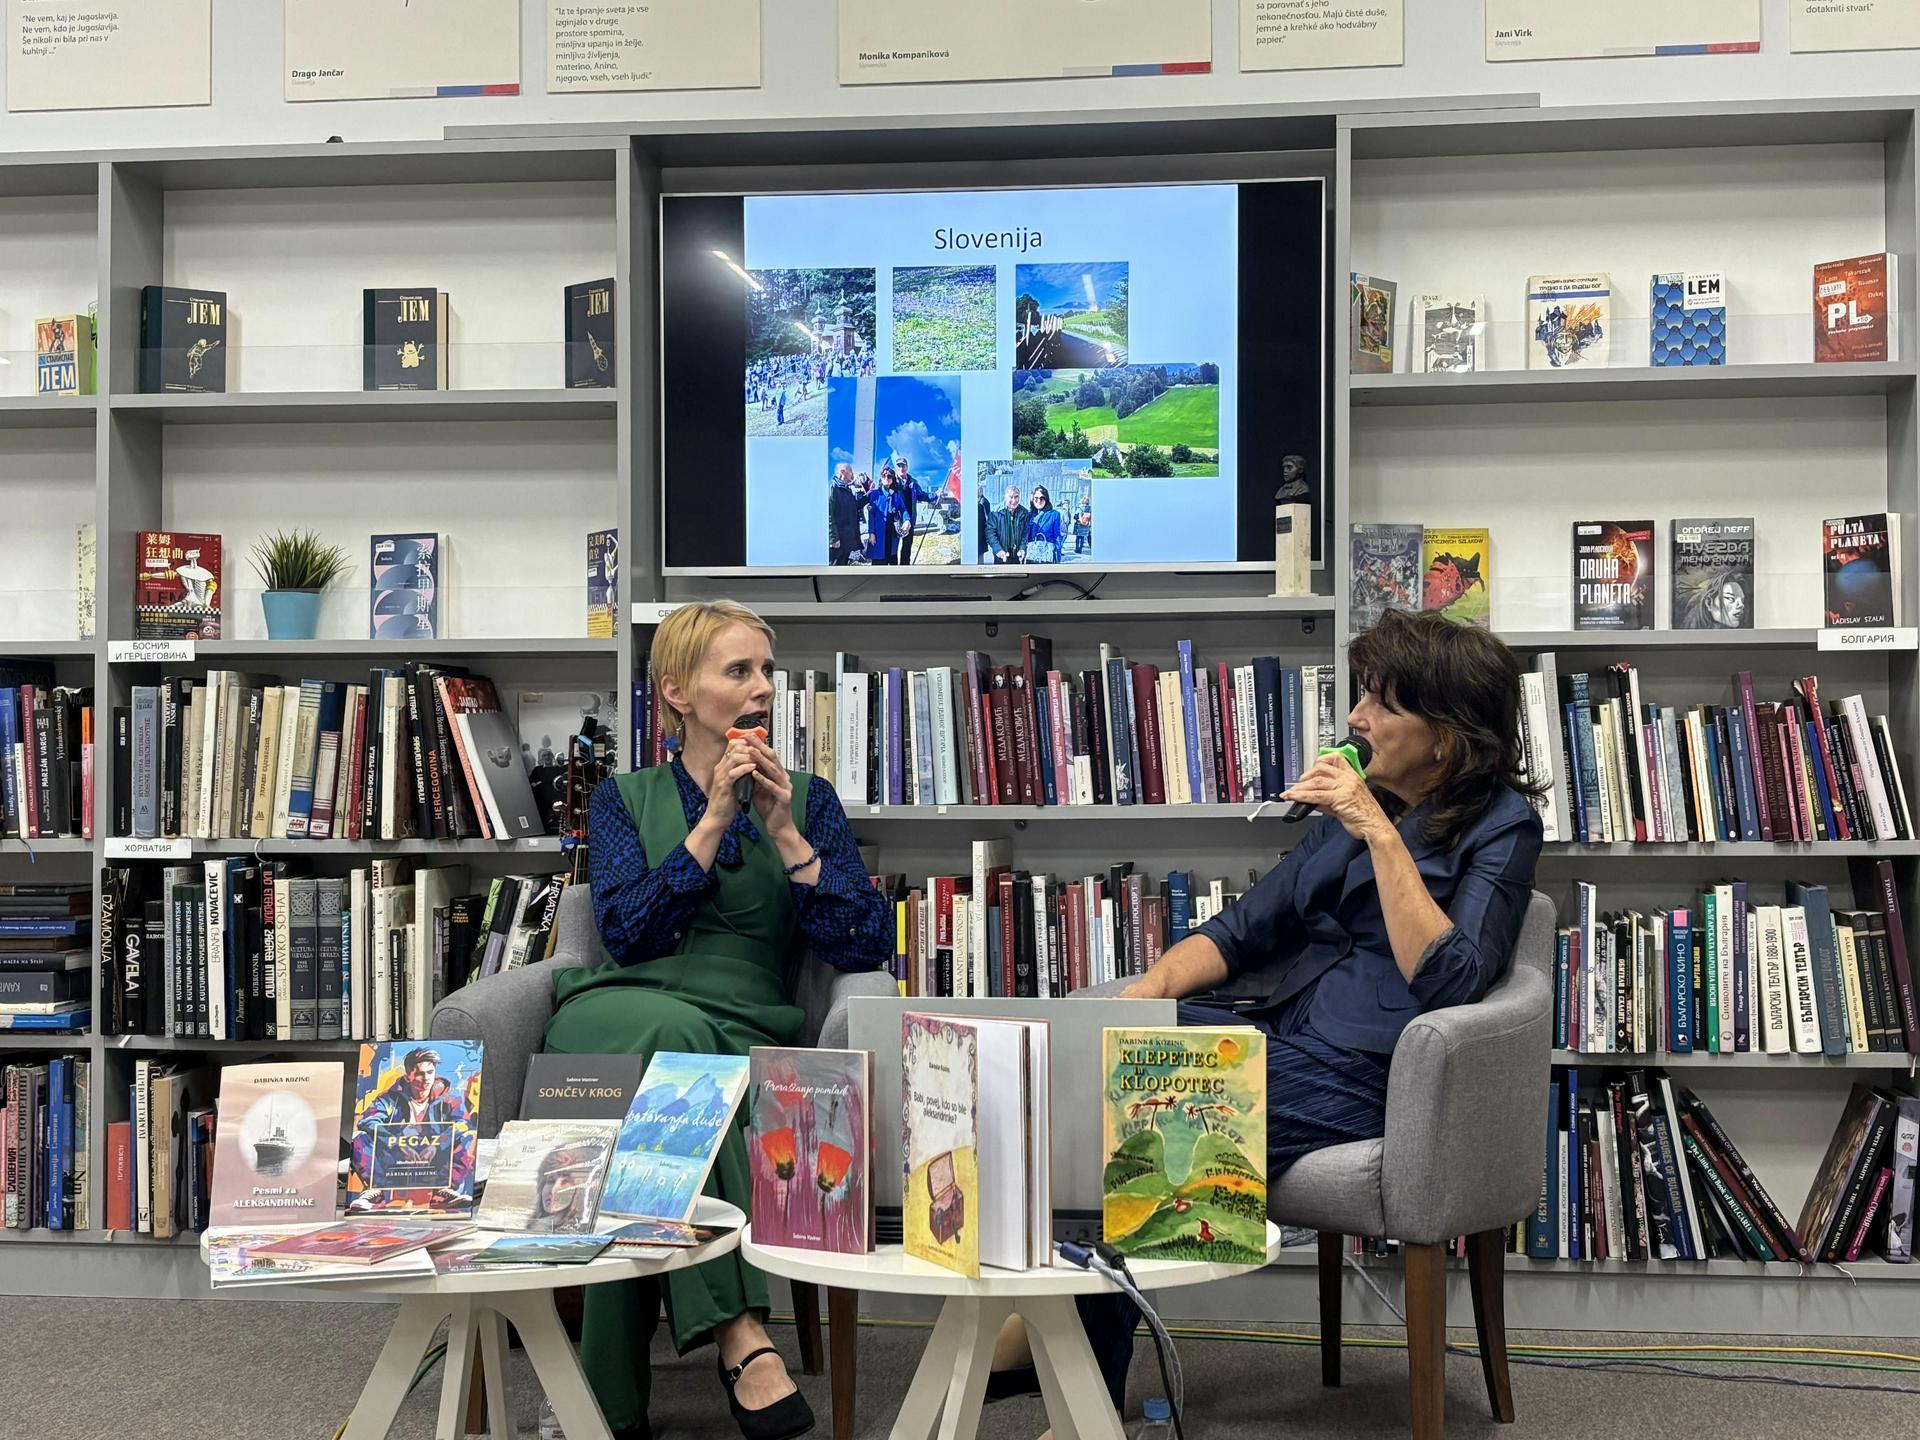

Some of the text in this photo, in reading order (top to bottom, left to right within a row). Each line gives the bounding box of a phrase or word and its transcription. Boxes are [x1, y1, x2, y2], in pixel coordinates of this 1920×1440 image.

[37, 12, 120, 24] vem, kaj je Jugoslavija.
[567, 8, 575, 16] te
[606, 7, 627, 15] sveta
[627, 7, 635, 15] je
[636, 6, 650, 14] vse
[1323, 9, 1344, 20] Majú
[1805, 4, 1844, 14] dotakniti
[22, 23, 120, 35] Ne vem, kdo je Jugoslavija.
[595, 18, 619, 28] druge
[1319, 22, 1335, 31] ako
[33, 35, 52, 45] nikoli
[54, 36, 62, 44] ni
[63, 34, 77, 44] bila
[78, 34, 89, 45] pri
[90, 35, 103, 43] nas
[555, 30, 588, 40] prostore
[615, 39, 623, 47] in
[1495, 28, 1534, 40] Jani Virk
[22, 46, 48, 57] kuhinji
[858, 50, 891, 62] Monika
[291, 68, 345, 80] Drago Jančar
[934, 227, 1042, 253] Slovenija
[1687, 278, 1721, 297] LEM
[39, 364, 77, 393] ЛЕМ
[1724, 525, 1751, 533] NEFF
[146, 547, 184, 560] 狂想曲
[1579, 580, 1631, 605] PLANÉTA
[1832, 616, 1861, 625] LADISLAV
[132, 641, 170, 651] БОСНИЯ
[1841, 634, 1895, 645] БОЛГАРИЯ
[115, 651, 188, 662] И ГЕРЦЕГОВИНА
[994, 706, 1008, 761] МЕДАКОВИЋ
[1013, 707, 1027, 762] МЕДАКОВИЋ
[40, 731, 49, 787] MARIÁN VARGA
[427, 749, 443, 820] HERCEGOVINA
[124, 843, 172, 854] ХОРВАТИЯ
[975, 854, 983, 922] MONOGRAFIJA
[540, 878, 562, 932] HRVATSKA
[262, 870, 275, 961] IVO ZAGREB
[101, 894, 114, 963] DŽAMONJA
[275, 892, 287, 978] SLAVKO SOHAJ
[341, 916, 350, 965] HRVATSKA
[185, 901, 194, 1013] 2 KULTURNA POVIJEST HRVATSKE
[198, 901, 206, 1013] 3 KULTURNA POVIJEST HRVATSKE
[251, 952, 260, 997] DUBROVNIK
[1720, 914, 1731, 1021] Символите на България
[1677, 943, 1688, 1028] БЪЛГАРСКО КИНО
[1766, 928, 1784, 1030] БЪЛГАРСКИ ТЕАТЪР 1880-1900
[1795, 942, 1814, 1023] БЪЛГАРСКИ ТЕАТЪР
[176, 1004, 182, 1012] 1
[1119, 1038, 1184, 1047] DARINKA KOZINC
[1120, 1048, 1218, 1068] KLEPETEC
[254, 1076, 310, 1085] DARINKA KOZINC
[1133, 1067, 1144, 1076] in
[538, 1085, 622, 1098] SONČEV KROG
[1120, 1075, 1225, 1094] KLOPOTEC
[913, 1090, 968, 1115] Babi, povej, kdo so bile
[626, 1109, 724, 1134] potovanja duše
[388, 1135, 441, 1148] PEGAZ
[1212, 1122, 1246, 1145] KLOP
[18, 1074, 28, 1222] СОКРОВИЩА СЛОВЕНИИ
[7, 1147, 17, 1193] СЛОВЕНИЯ
[1656, 1121, 1683, 1214] TREASURES OF BULGARIA
[252, 1186, 297, 1195] Pesmi za
[1690, 1143, 1752, 1233] The Little Gift Book of BULGARIA
[233, 1197, 315, 1209] ALEKSANDRINKE
[1863, 1202, 1879, 1229] СОФИЯ
